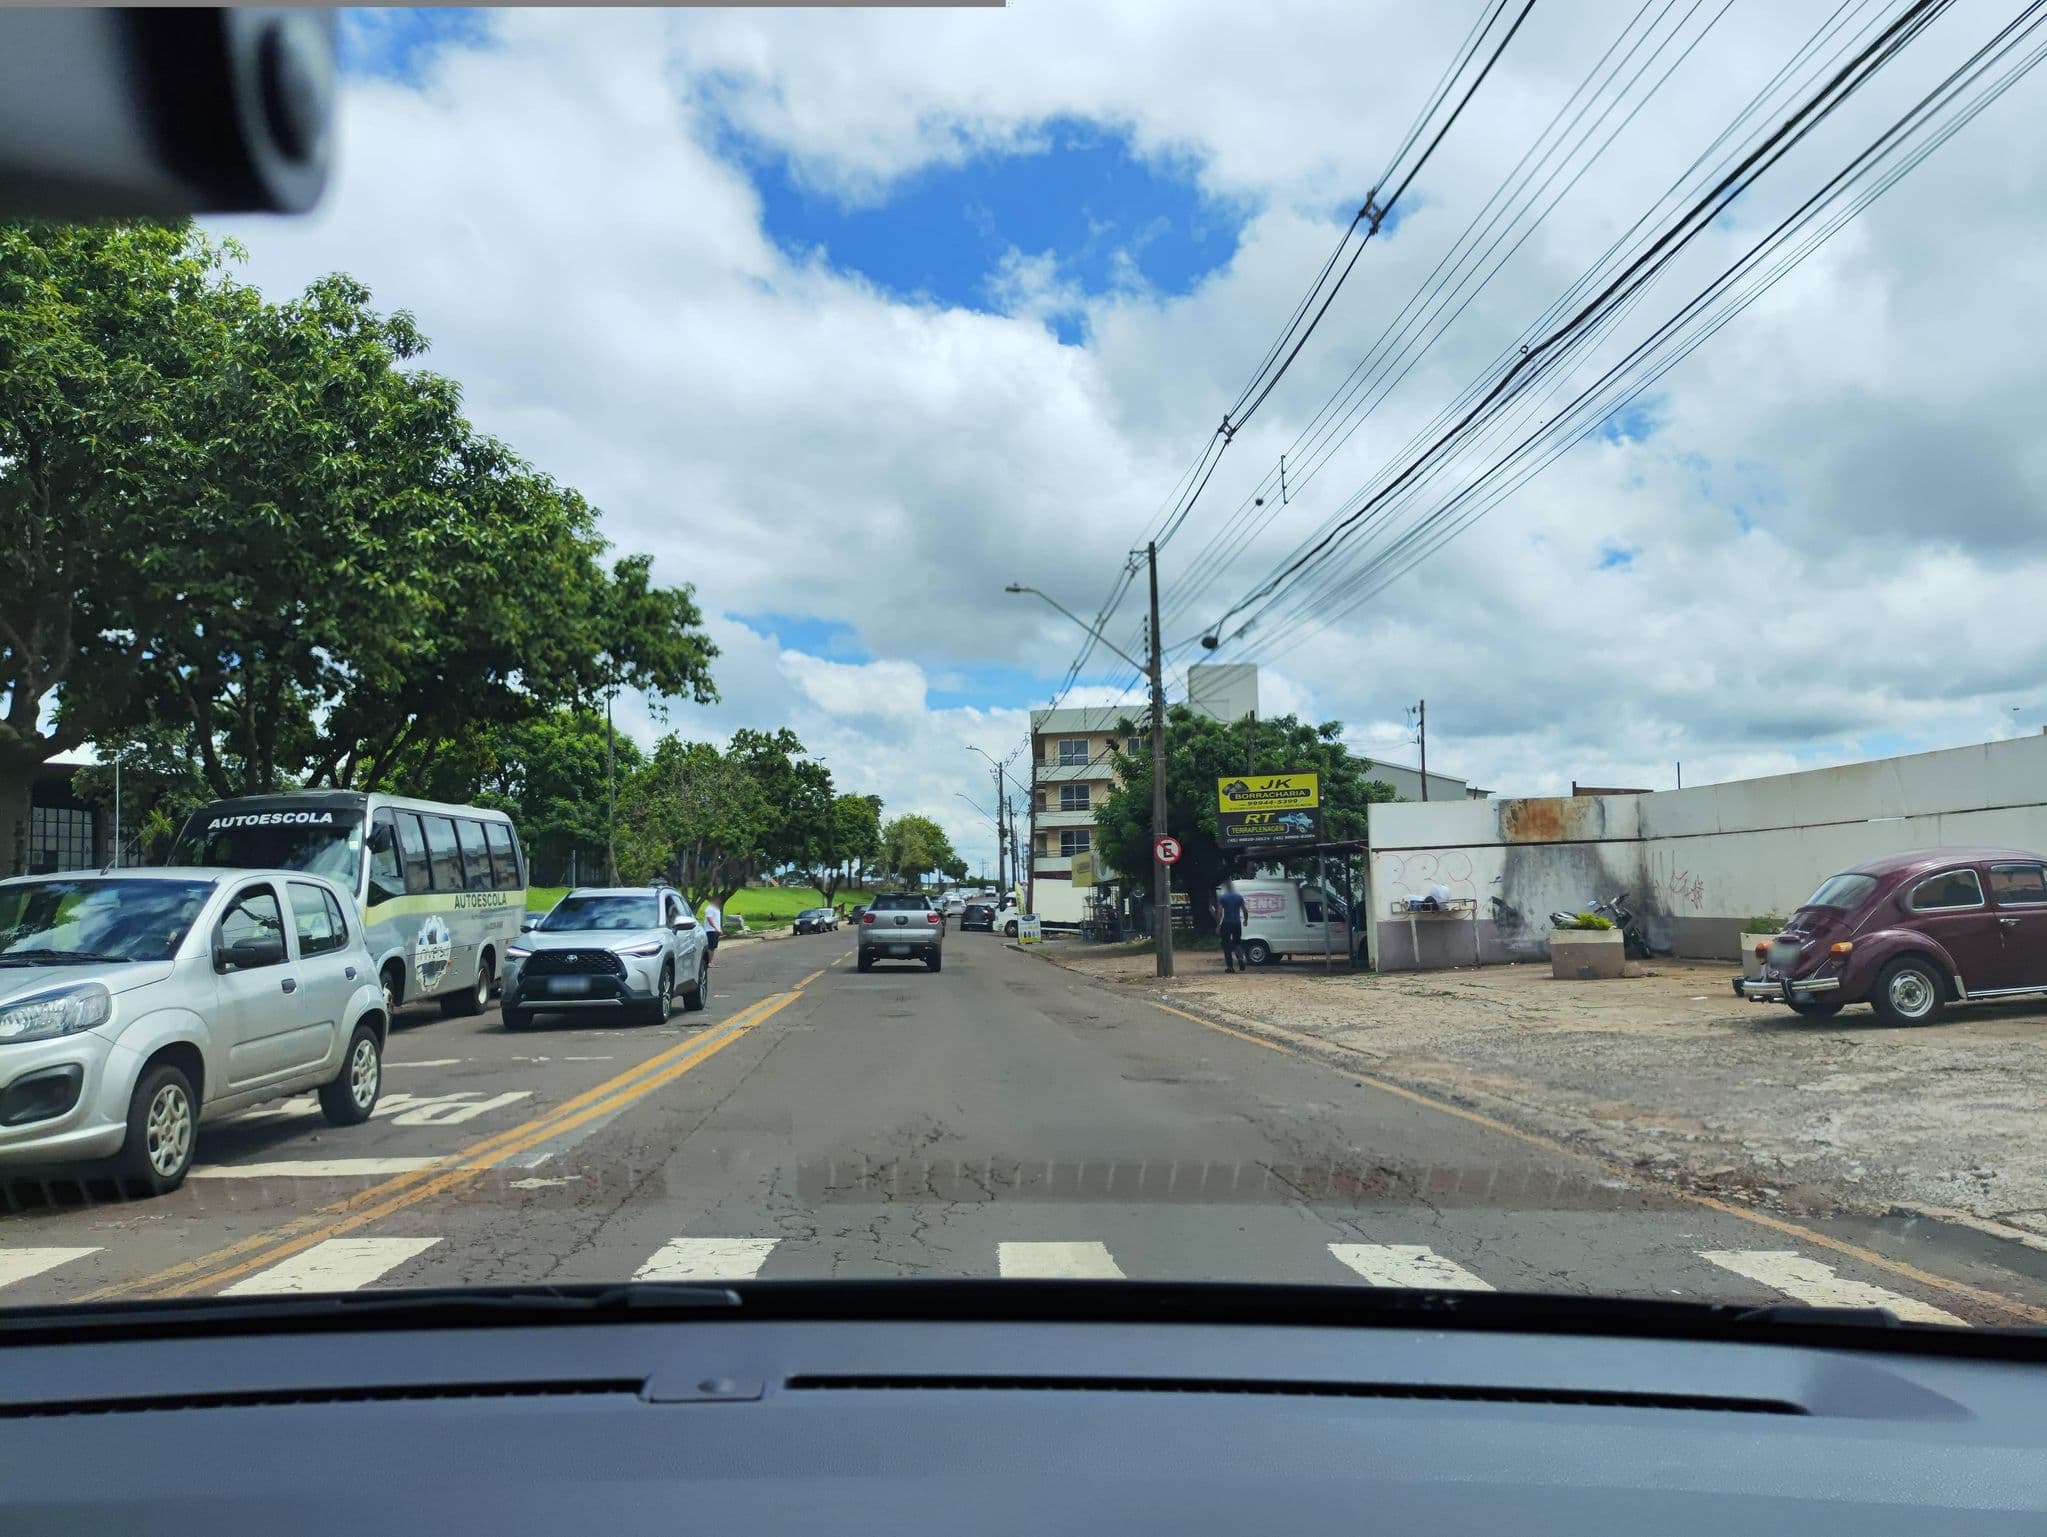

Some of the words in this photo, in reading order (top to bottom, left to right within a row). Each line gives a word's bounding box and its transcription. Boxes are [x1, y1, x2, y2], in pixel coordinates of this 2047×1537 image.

[1260, 778, 1292, 789] JK
[1234, 790, 1306, 800] BORRACHARIA
[207, 812, 333, 829] AUTOESCOLA
[1244, 812, 1276, 823] RT
[454, 893, 507, 909] AUTOESCOLA
